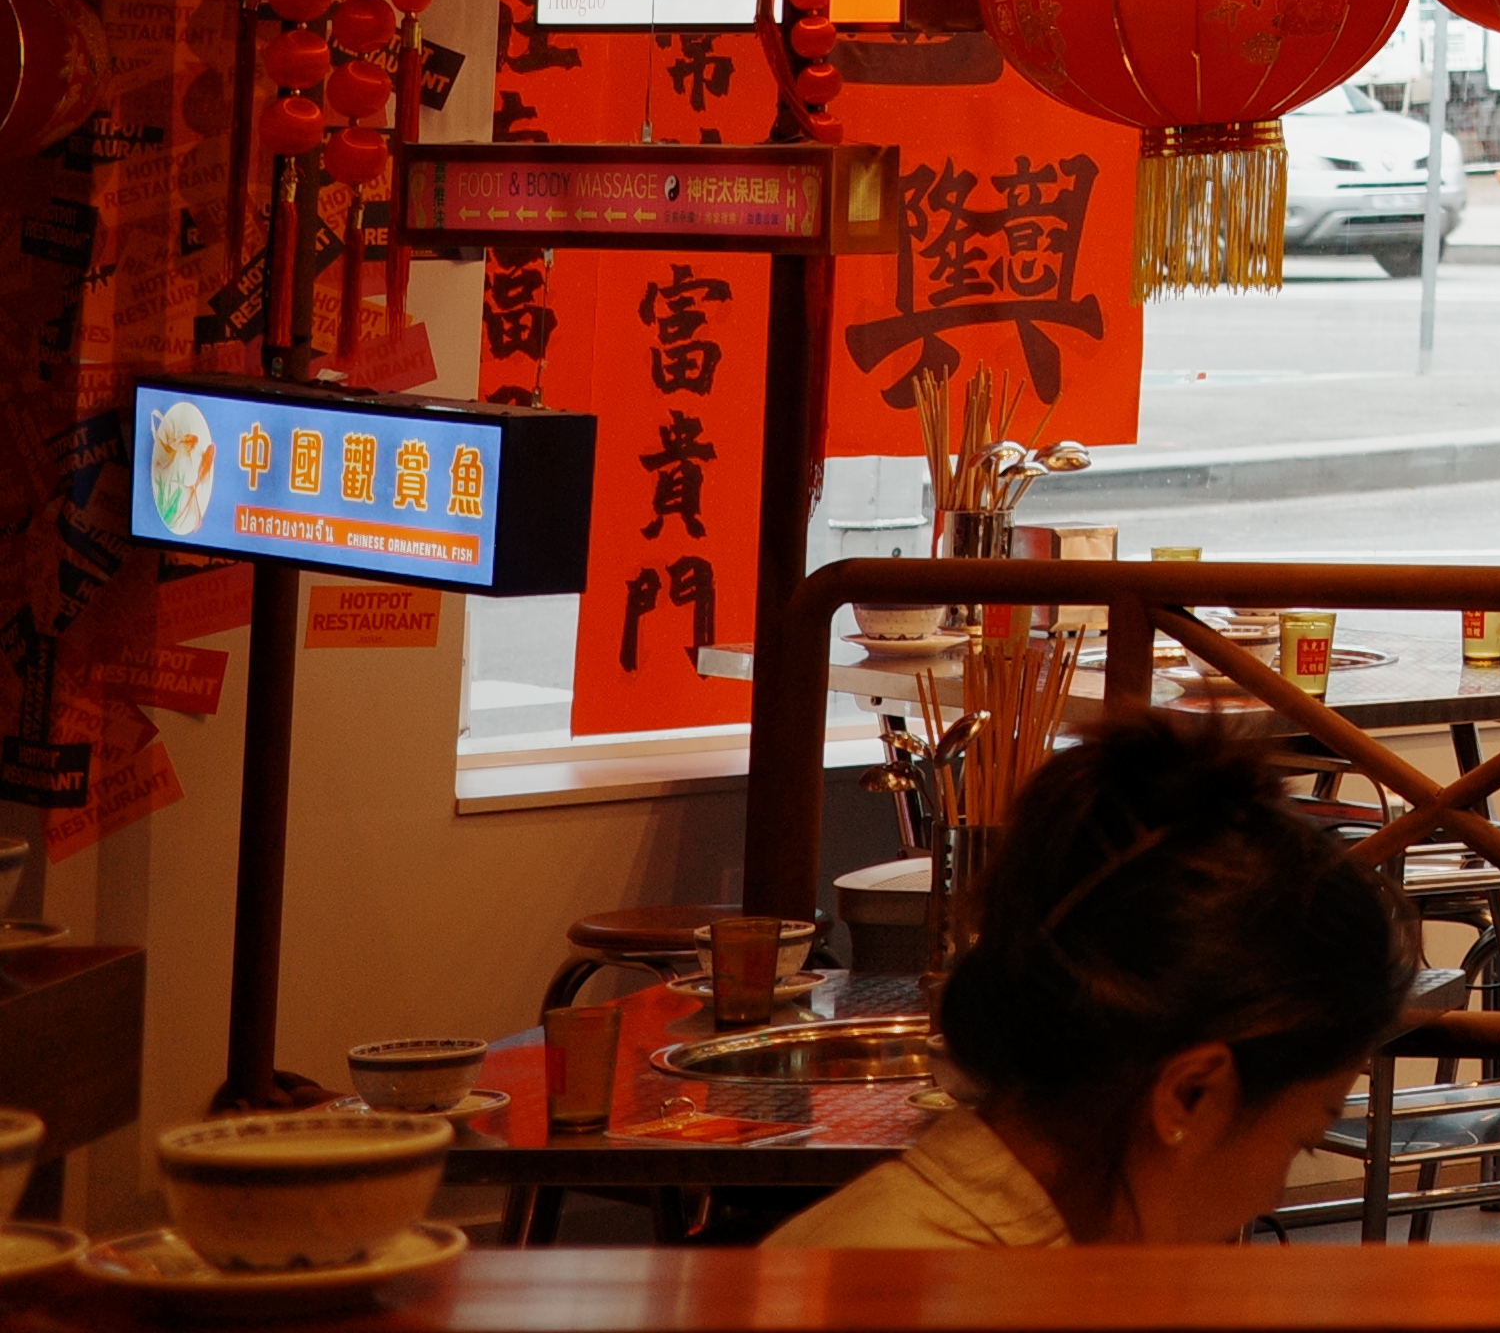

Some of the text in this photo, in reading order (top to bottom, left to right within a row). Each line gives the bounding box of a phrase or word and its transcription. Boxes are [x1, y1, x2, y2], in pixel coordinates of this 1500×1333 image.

[457, 170, 659, 201] FOOT & BODY MASSAGE
[237, 421, 486, 522] 中國觀賞魚
[238, 511, 336, 546] ปลาสวยงามจีน
[345, 530, 387, 554] CHINESE
[450, 545, 474, 564] FISH
[338, 591, 413, 612] HOTPOT
[311, 612, 438, 633] RESTAURANT
